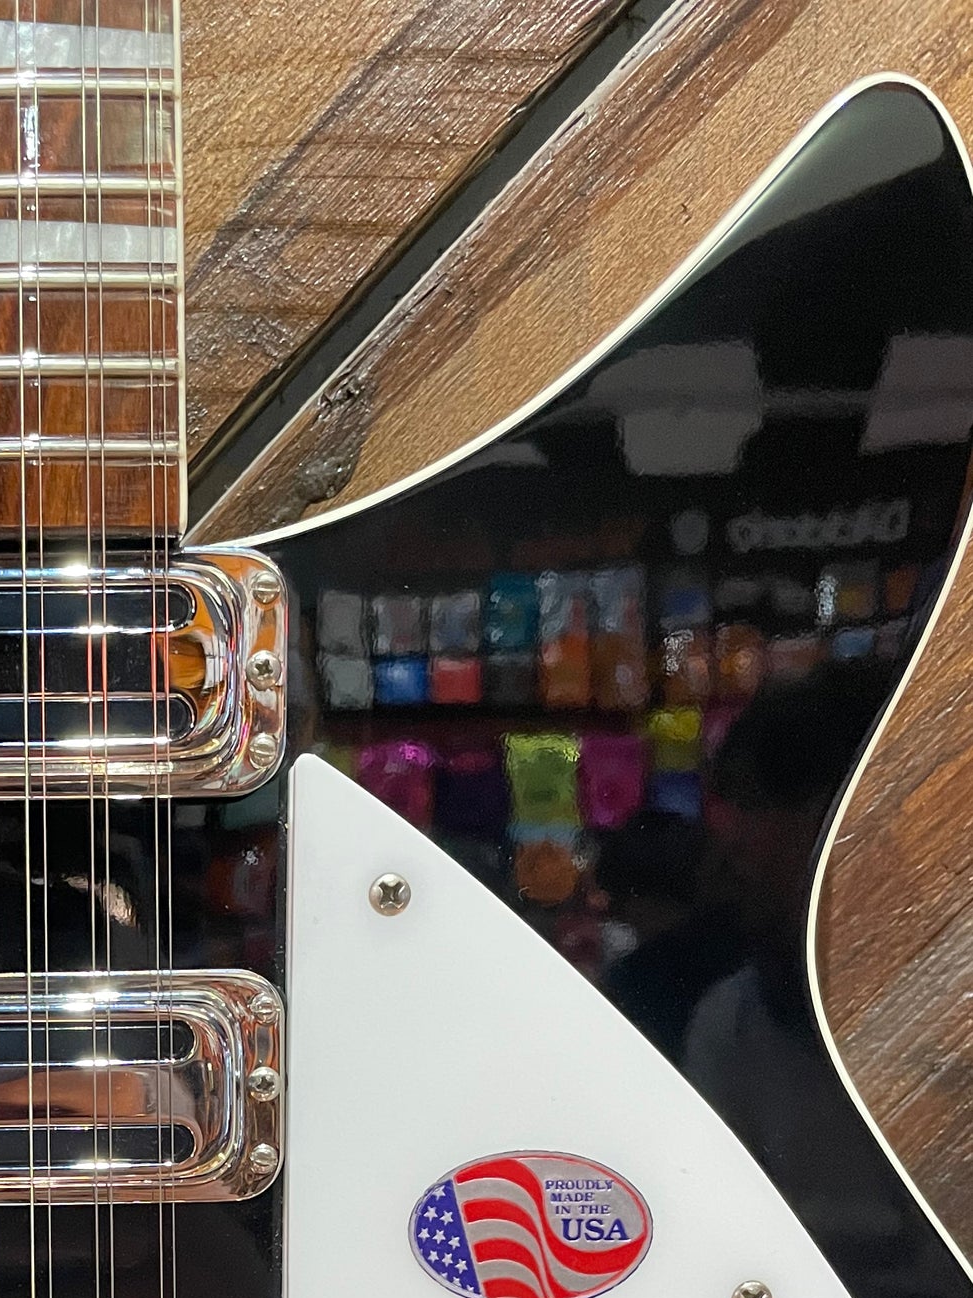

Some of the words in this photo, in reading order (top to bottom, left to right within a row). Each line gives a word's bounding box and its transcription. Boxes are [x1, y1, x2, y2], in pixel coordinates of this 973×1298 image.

[545, 1180, 614, 1190] PROUDLY
[550, 1192, 595, 1202] MADE
[555, 1205, 571, 1214] IN
[578, 1205, 611, 1214] THE
[561, 1219, 629, 1241] USA
